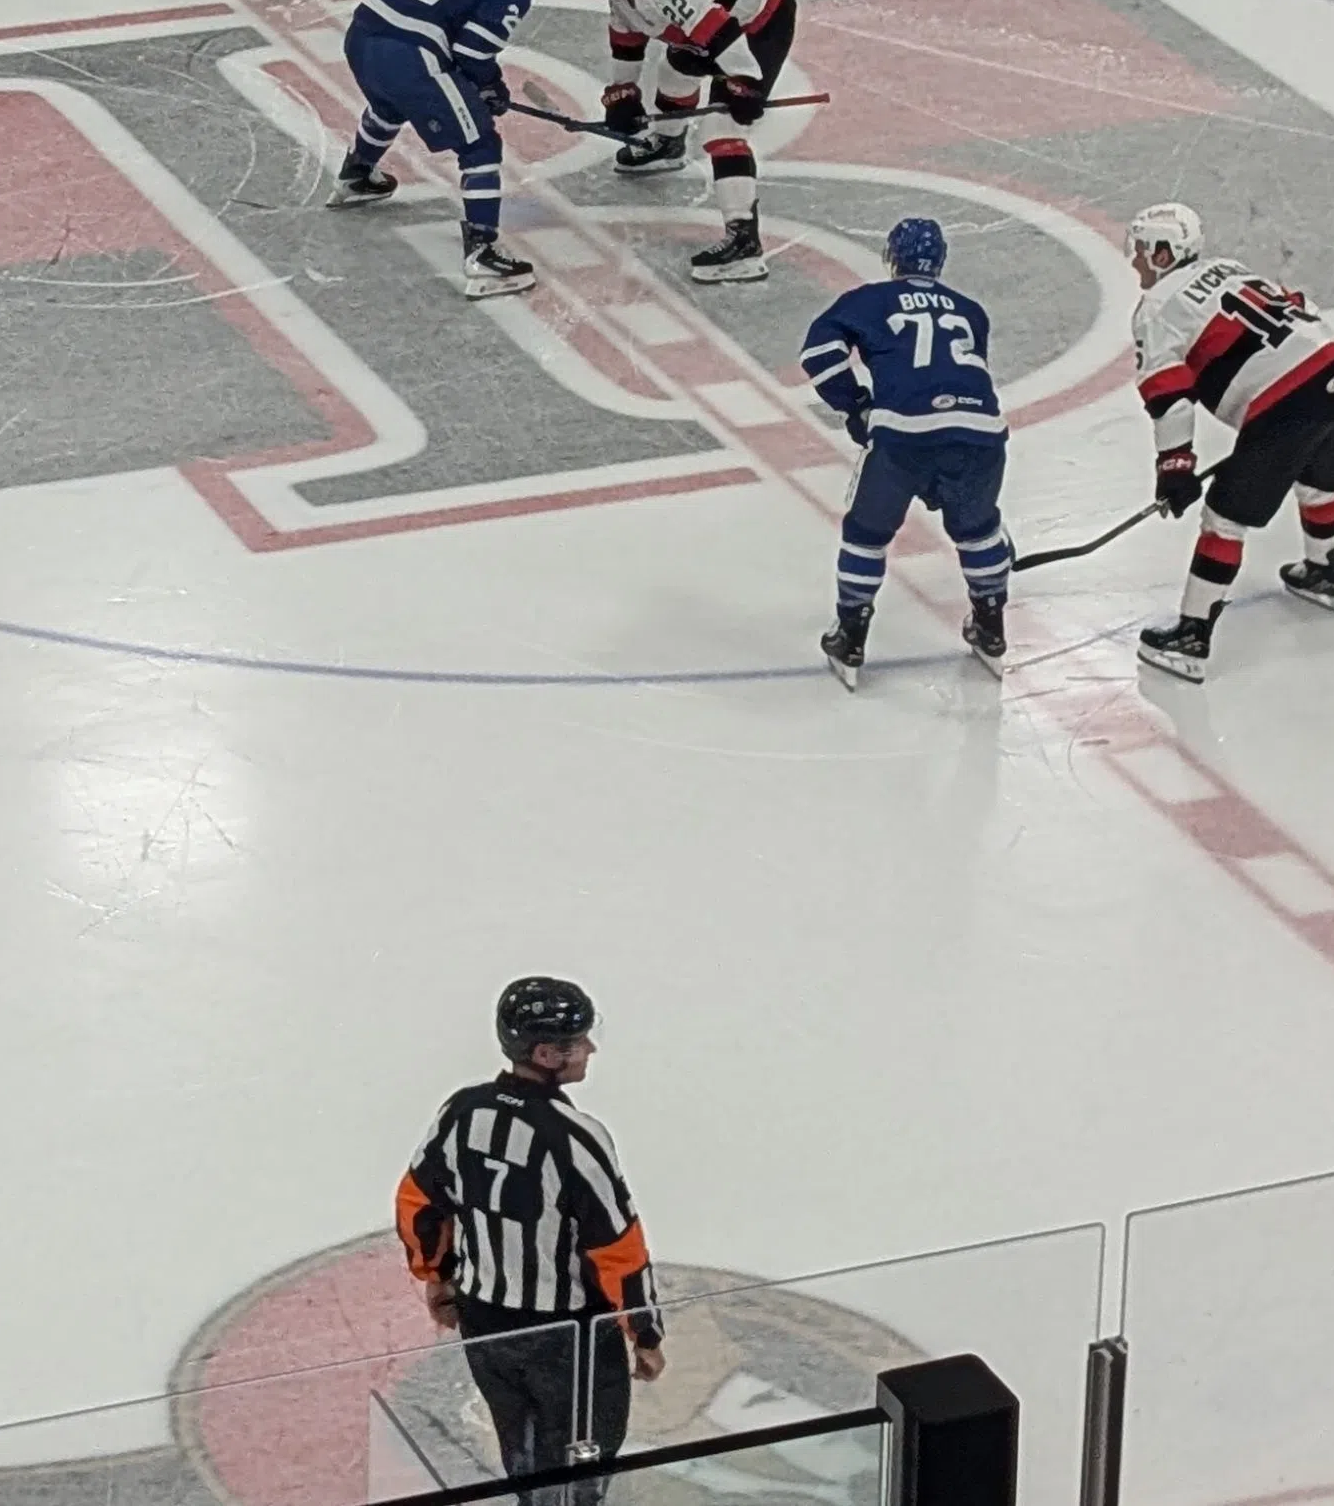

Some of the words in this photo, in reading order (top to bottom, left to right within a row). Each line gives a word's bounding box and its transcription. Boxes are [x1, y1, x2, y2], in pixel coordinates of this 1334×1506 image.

[899, 292, 955, 311] BOYD
[887, 312, 988, 369] 72
[484, 1158, 510, 1213] 7
